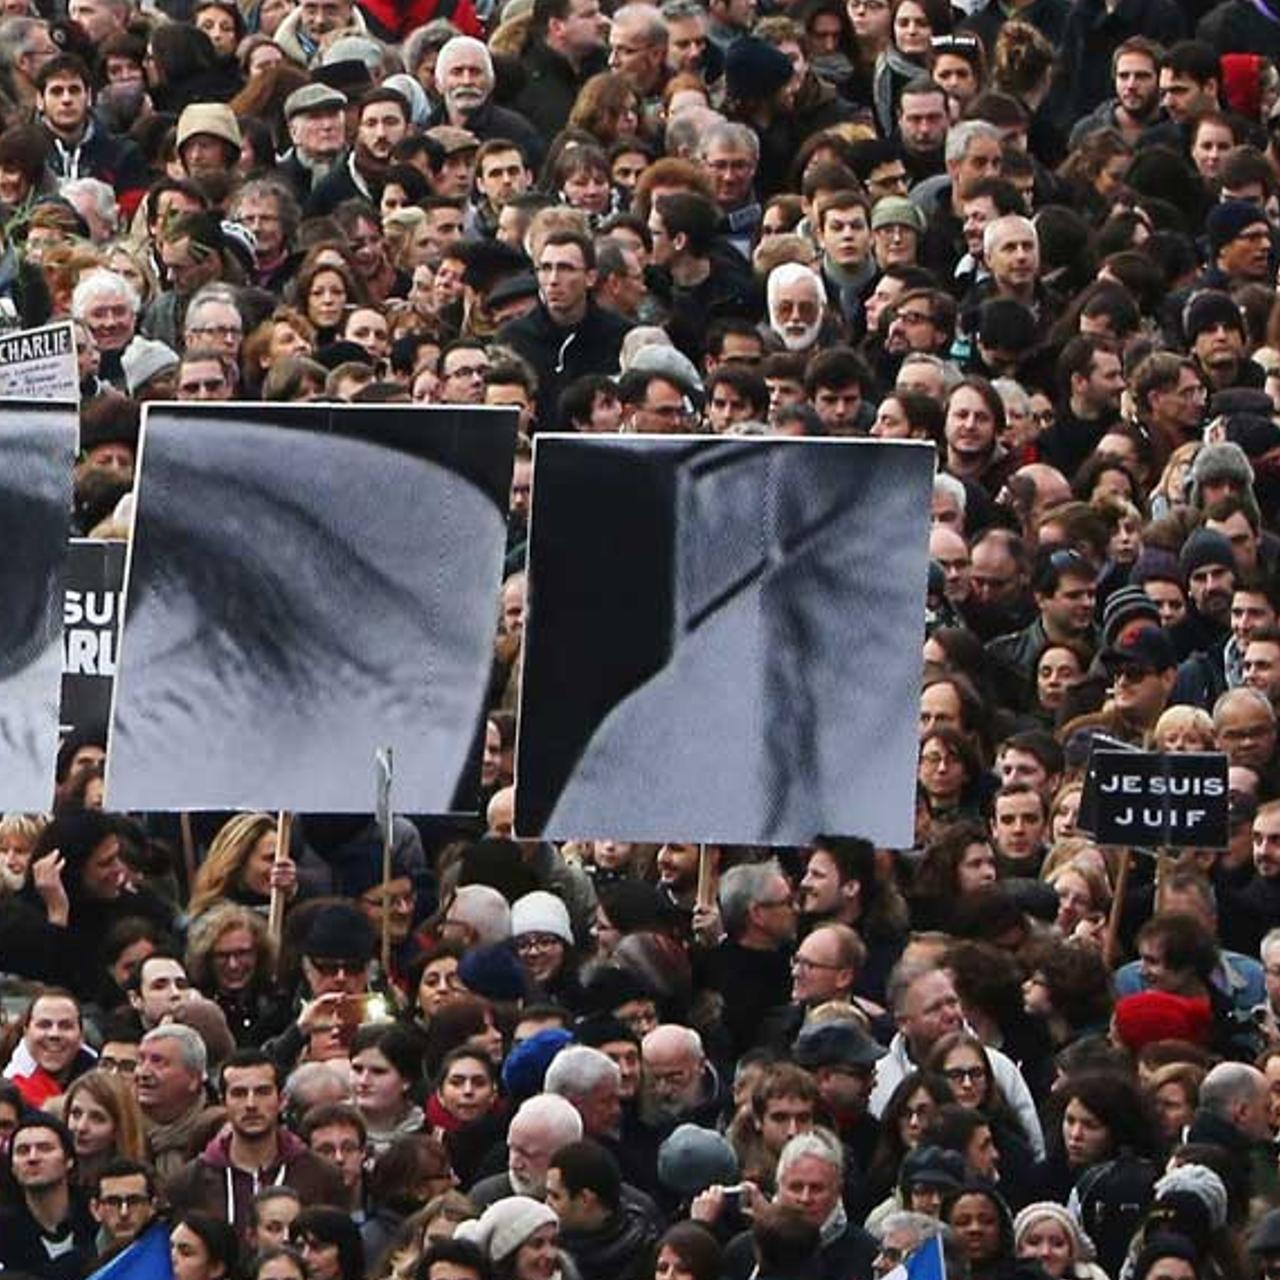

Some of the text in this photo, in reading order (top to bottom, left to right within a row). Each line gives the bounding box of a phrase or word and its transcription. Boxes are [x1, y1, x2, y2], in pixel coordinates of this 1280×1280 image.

[62, 590, 114, 625] SU
[1100, 775, 1226, 797] JE SUIS
[1114, 807, 1207, 829] JUIF
